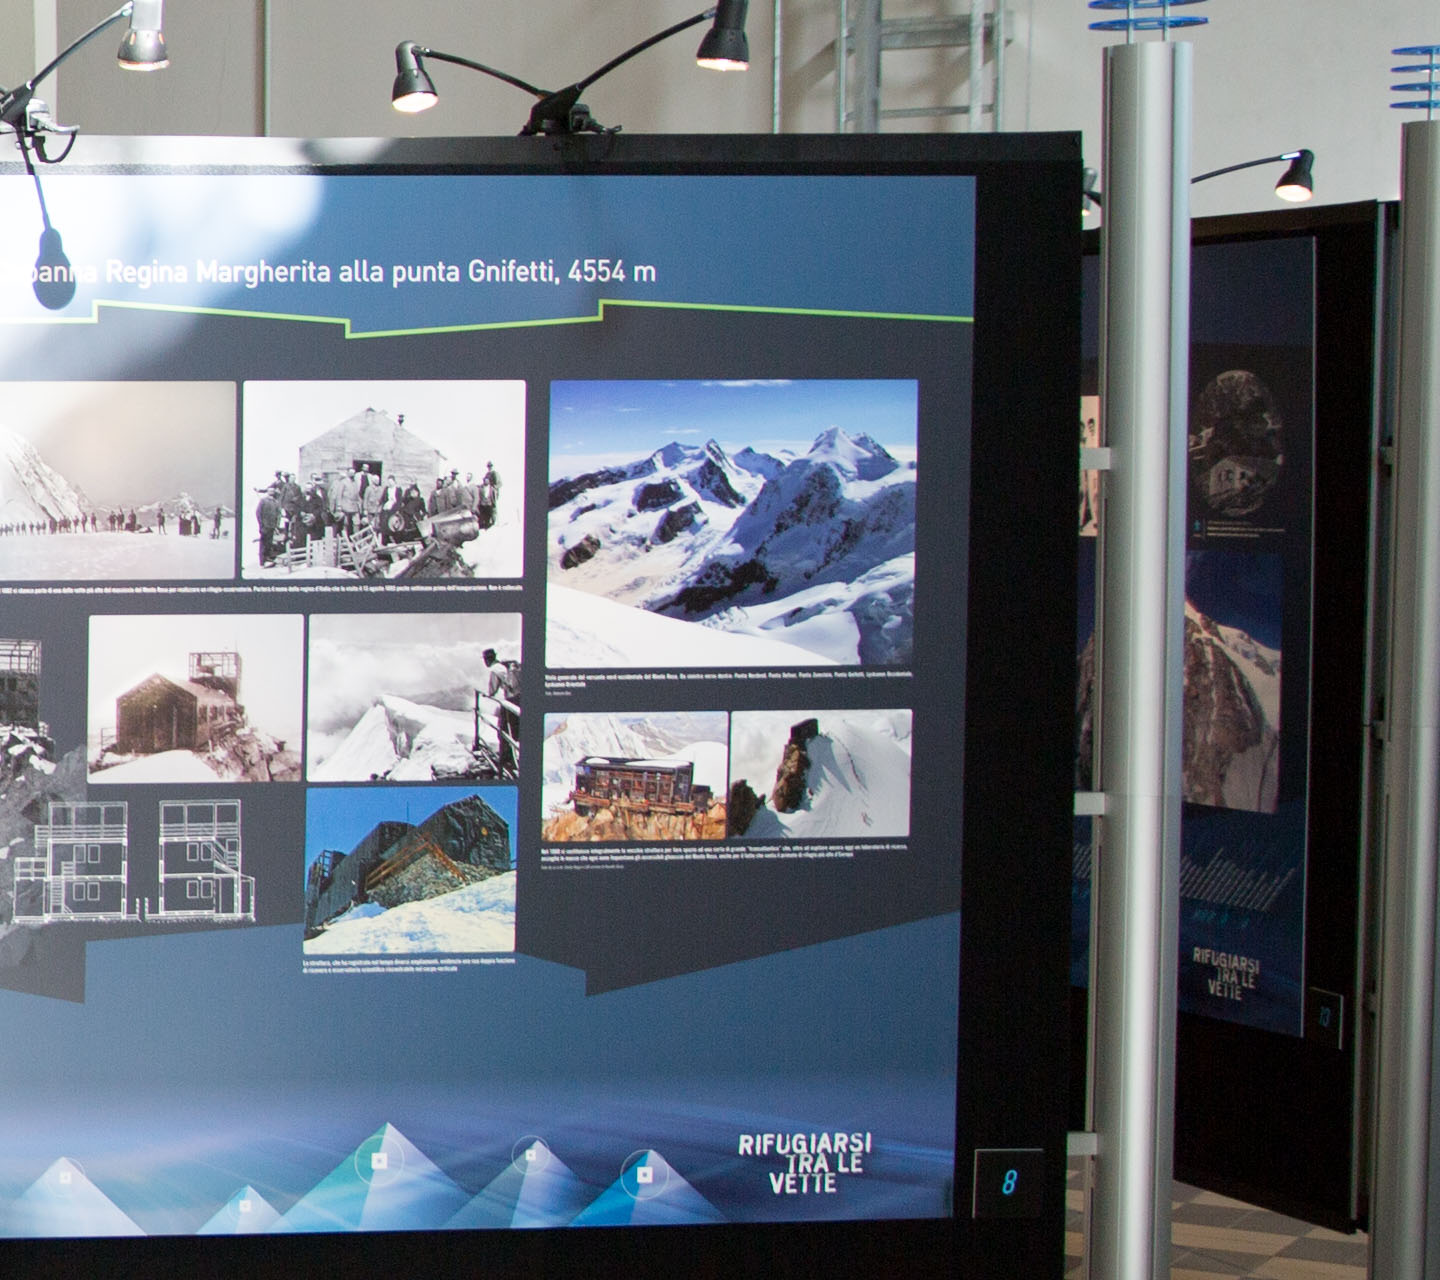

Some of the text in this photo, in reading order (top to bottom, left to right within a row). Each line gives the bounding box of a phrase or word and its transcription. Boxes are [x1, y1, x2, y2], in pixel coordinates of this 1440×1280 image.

[104, 258, 189, 289] Regina
[195, 258, 331, 289] Margherita
[338, 258, 384, 283] alla
[392, 261, 460, 288] punta
[467, 258, 561, 286] Gnifetti,
[568, 259, 626, 283] 4554
[633, 265, 656, 283] m
[1193, 946, 1260, 975] RIFUGIARSI
[1207, 977, 1243, 1001] VETTE
[1216, 967, 1257, 989] TRA LE
[738, 1131, 872, 1156] RIFUGIARSI
[785, 1152, 864, 1174] TRA LE
[768, 1172, 837, 1194] VETTE
[1001, 1169, 1018, 1196] 8
